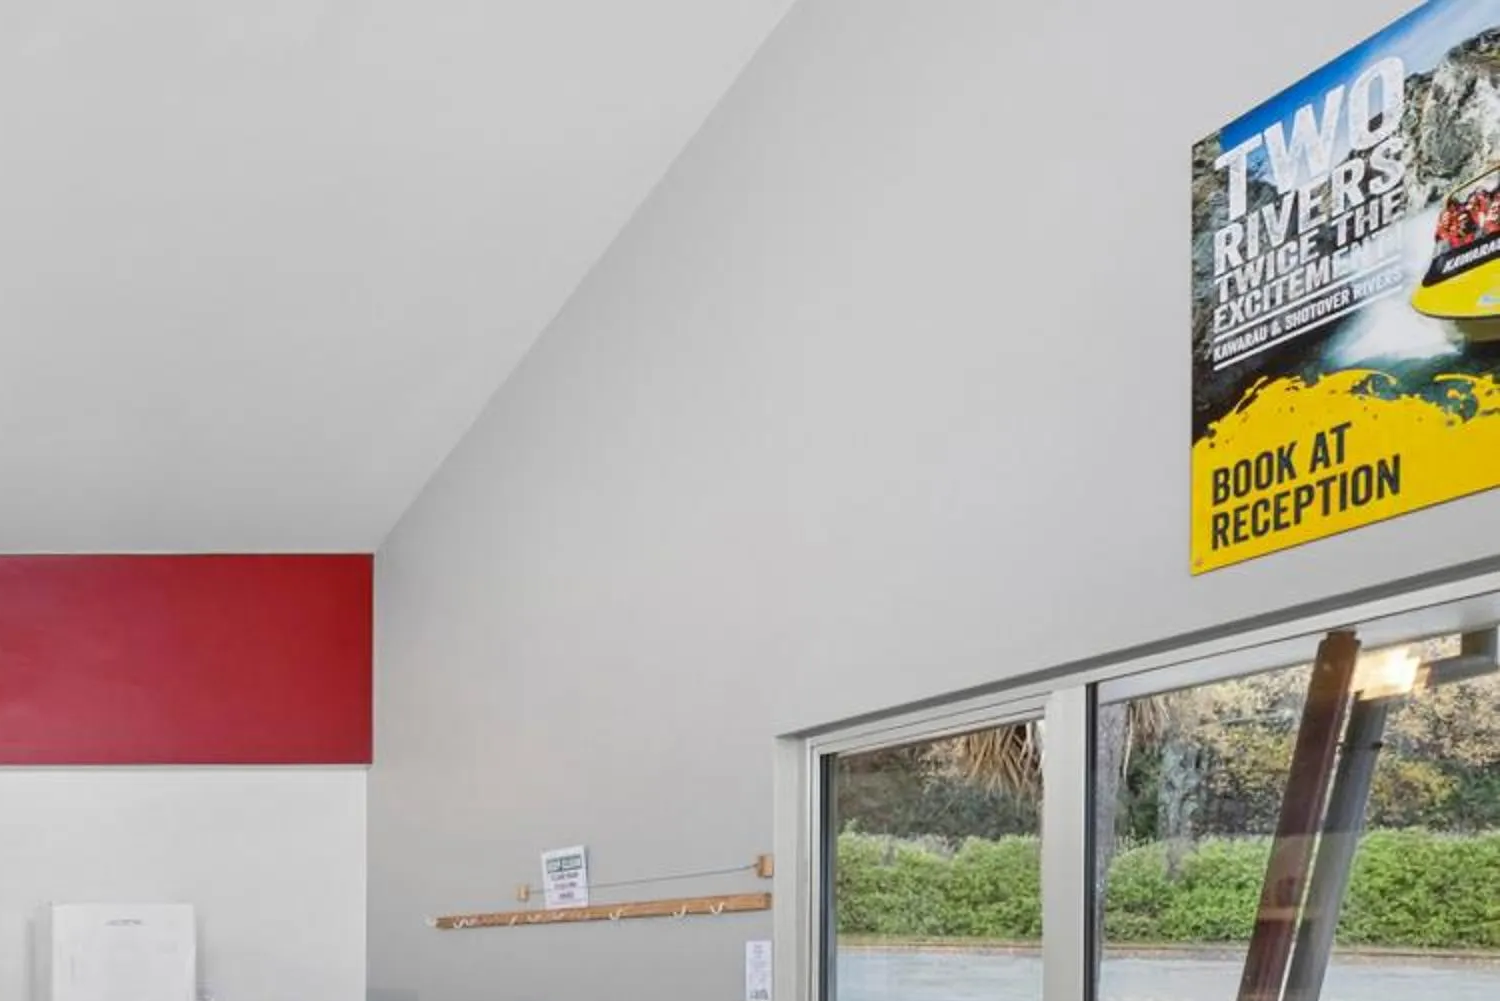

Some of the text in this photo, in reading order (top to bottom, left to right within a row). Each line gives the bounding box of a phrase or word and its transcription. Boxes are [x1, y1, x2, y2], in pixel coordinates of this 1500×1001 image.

[1214, 56, 1405, 221] TWO
[1214, 136, 1406, 277] RIVERS
[1214, 188, 1406, 303] TWICE THE
[1213, 267, 1404, 363] KAWARAU & SHOTOVER RIVERS
[1211, 453, 1401, 551] RECEPTION
[1212, 421, 1352, 507] BOOK AT
